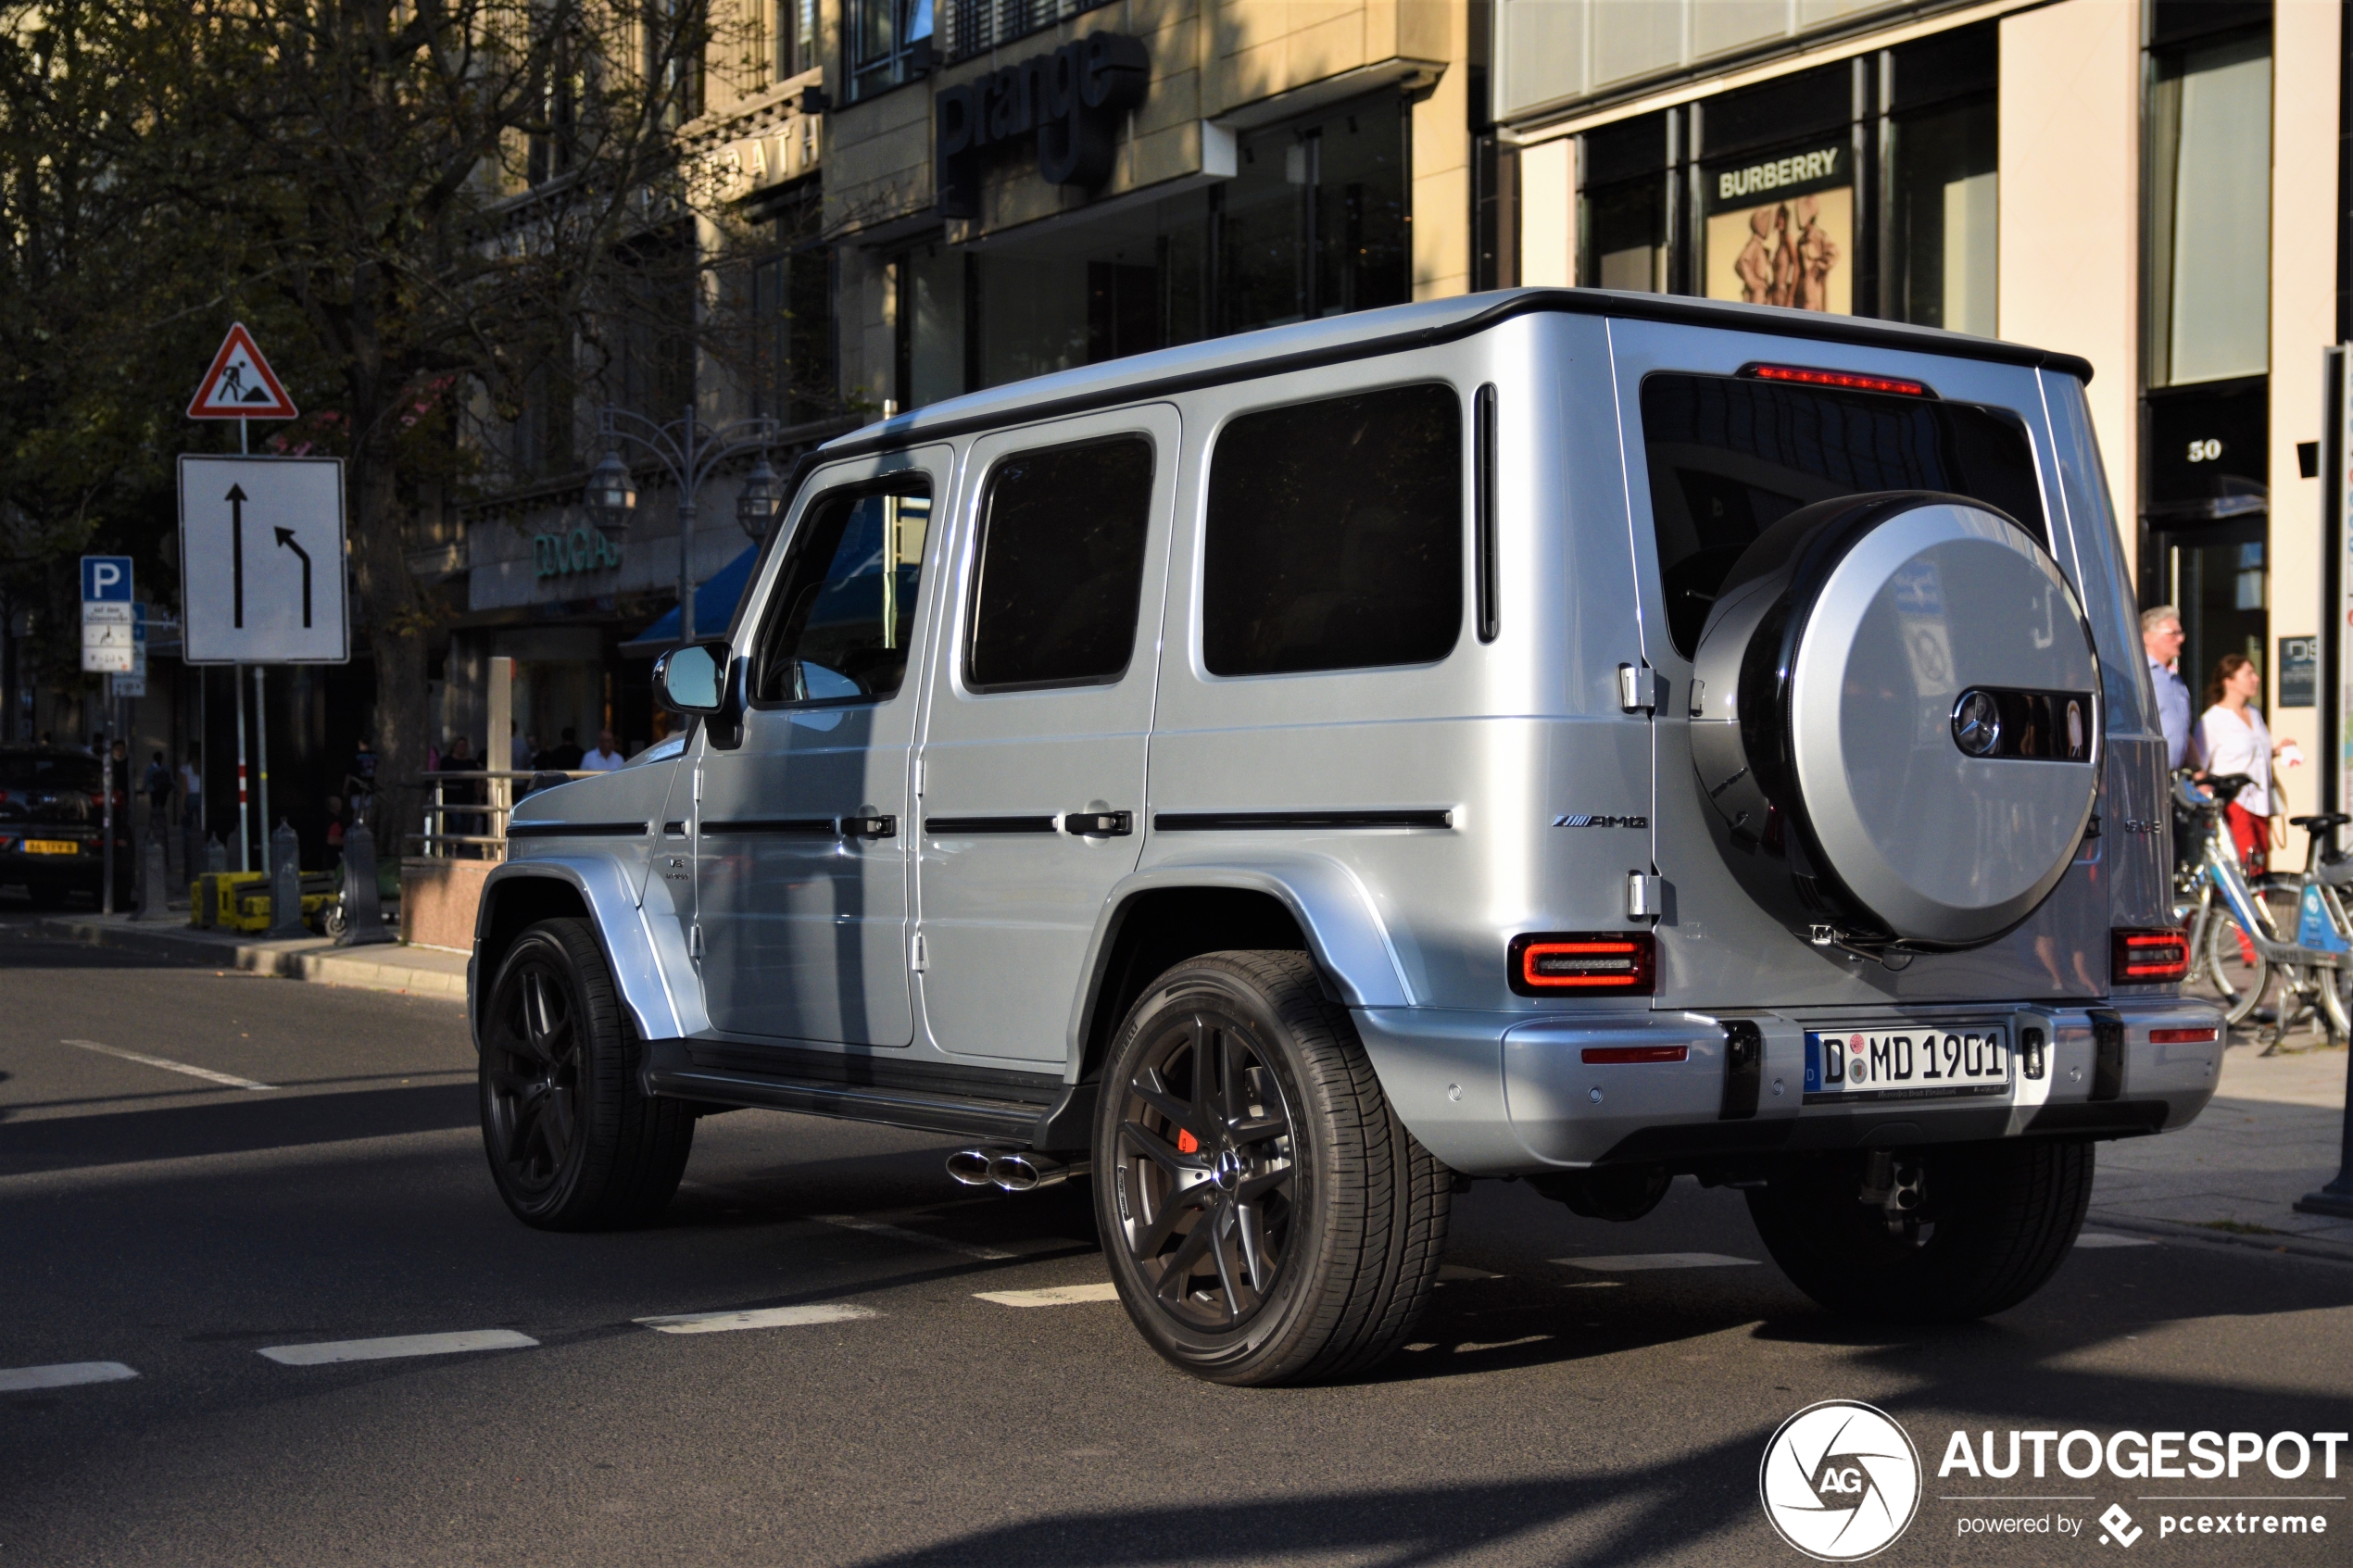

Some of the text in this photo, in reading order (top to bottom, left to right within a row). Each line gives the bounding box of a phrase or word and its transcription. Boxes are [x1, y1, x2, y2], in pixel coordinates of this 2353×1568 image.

[936, 31, 1151, 219] prange
[1719, 146, 1838, 199] BURBERRY
[2187, 438, 2222, 462] 50
[93, 561, 121, 599] P
[1587, 815, 1648, 829] AMG
[1824, 1032, 2003, 1084] D MD 1901
